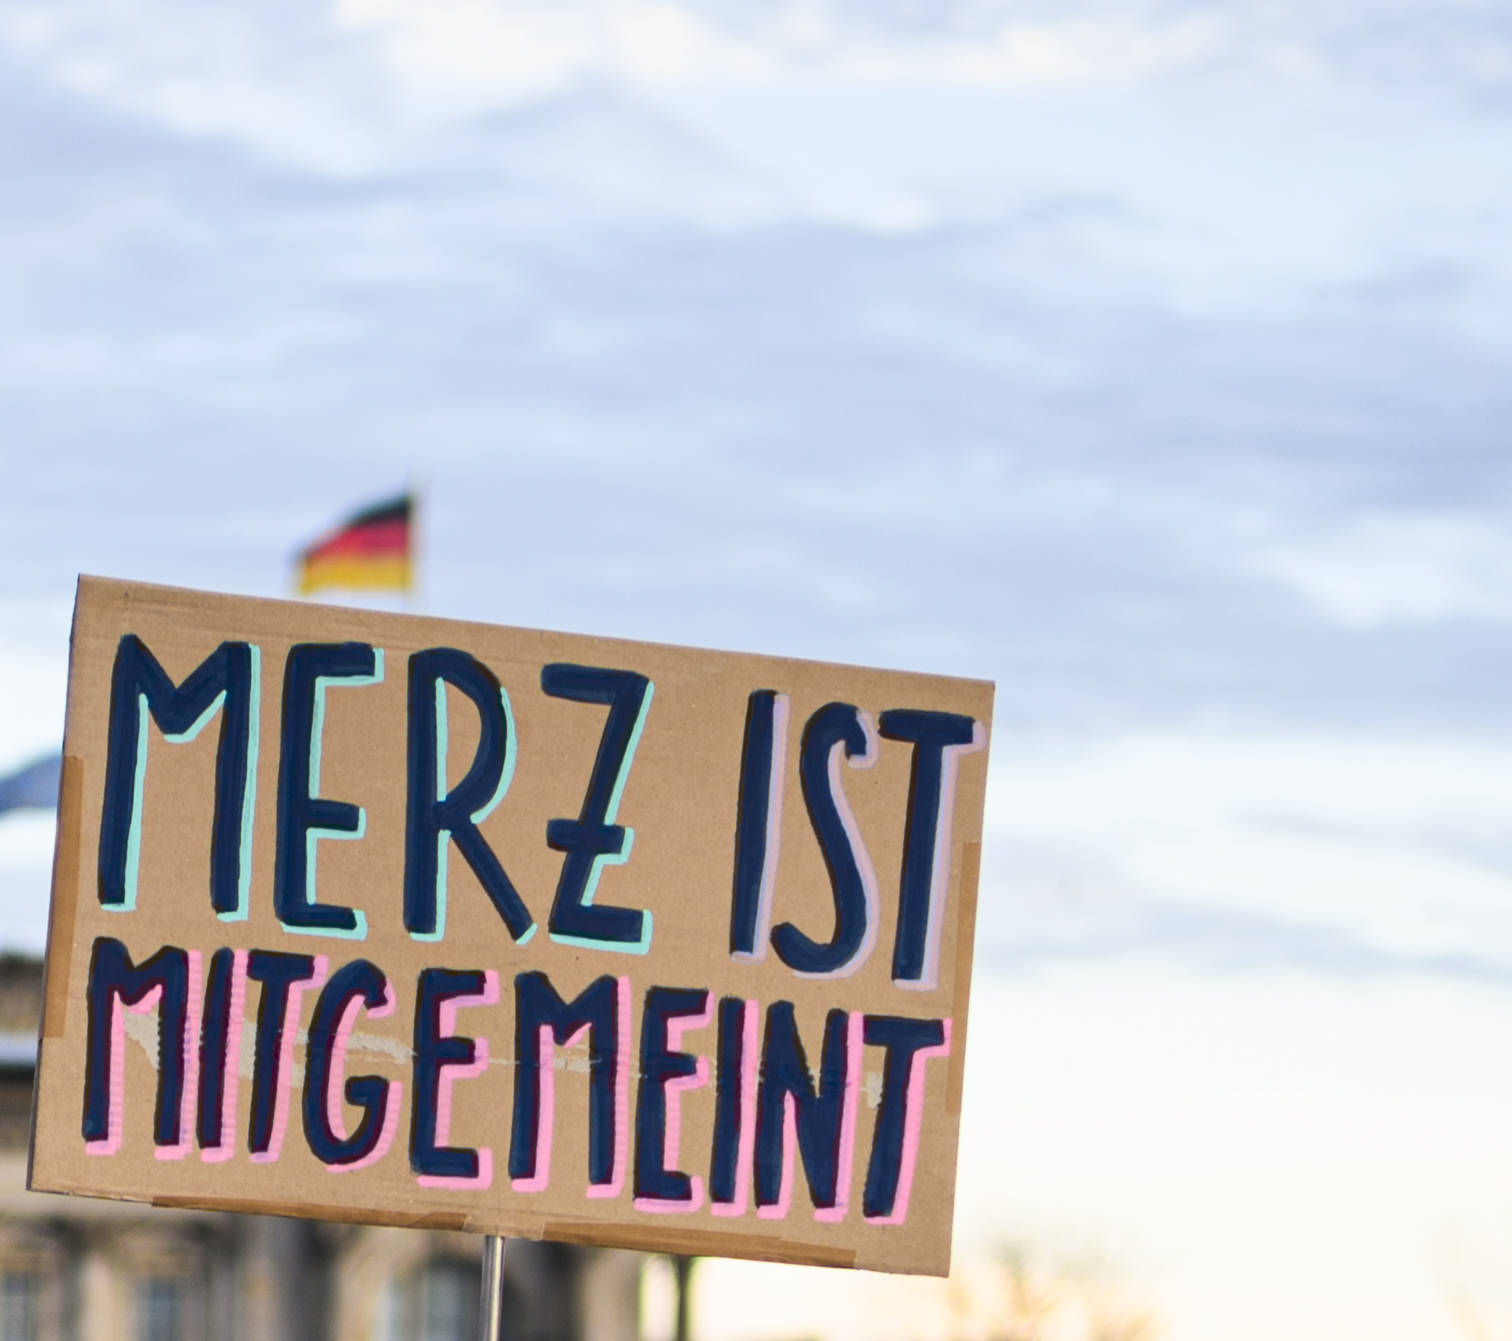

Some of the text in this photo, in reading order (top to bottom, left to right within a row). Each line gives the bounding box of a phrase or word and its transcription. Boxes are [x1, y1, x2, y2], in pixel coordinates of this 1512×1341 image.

[97, 632, 984, 990] MERZ IST
[82, 935, 953, 1225] MITGEMEINT
